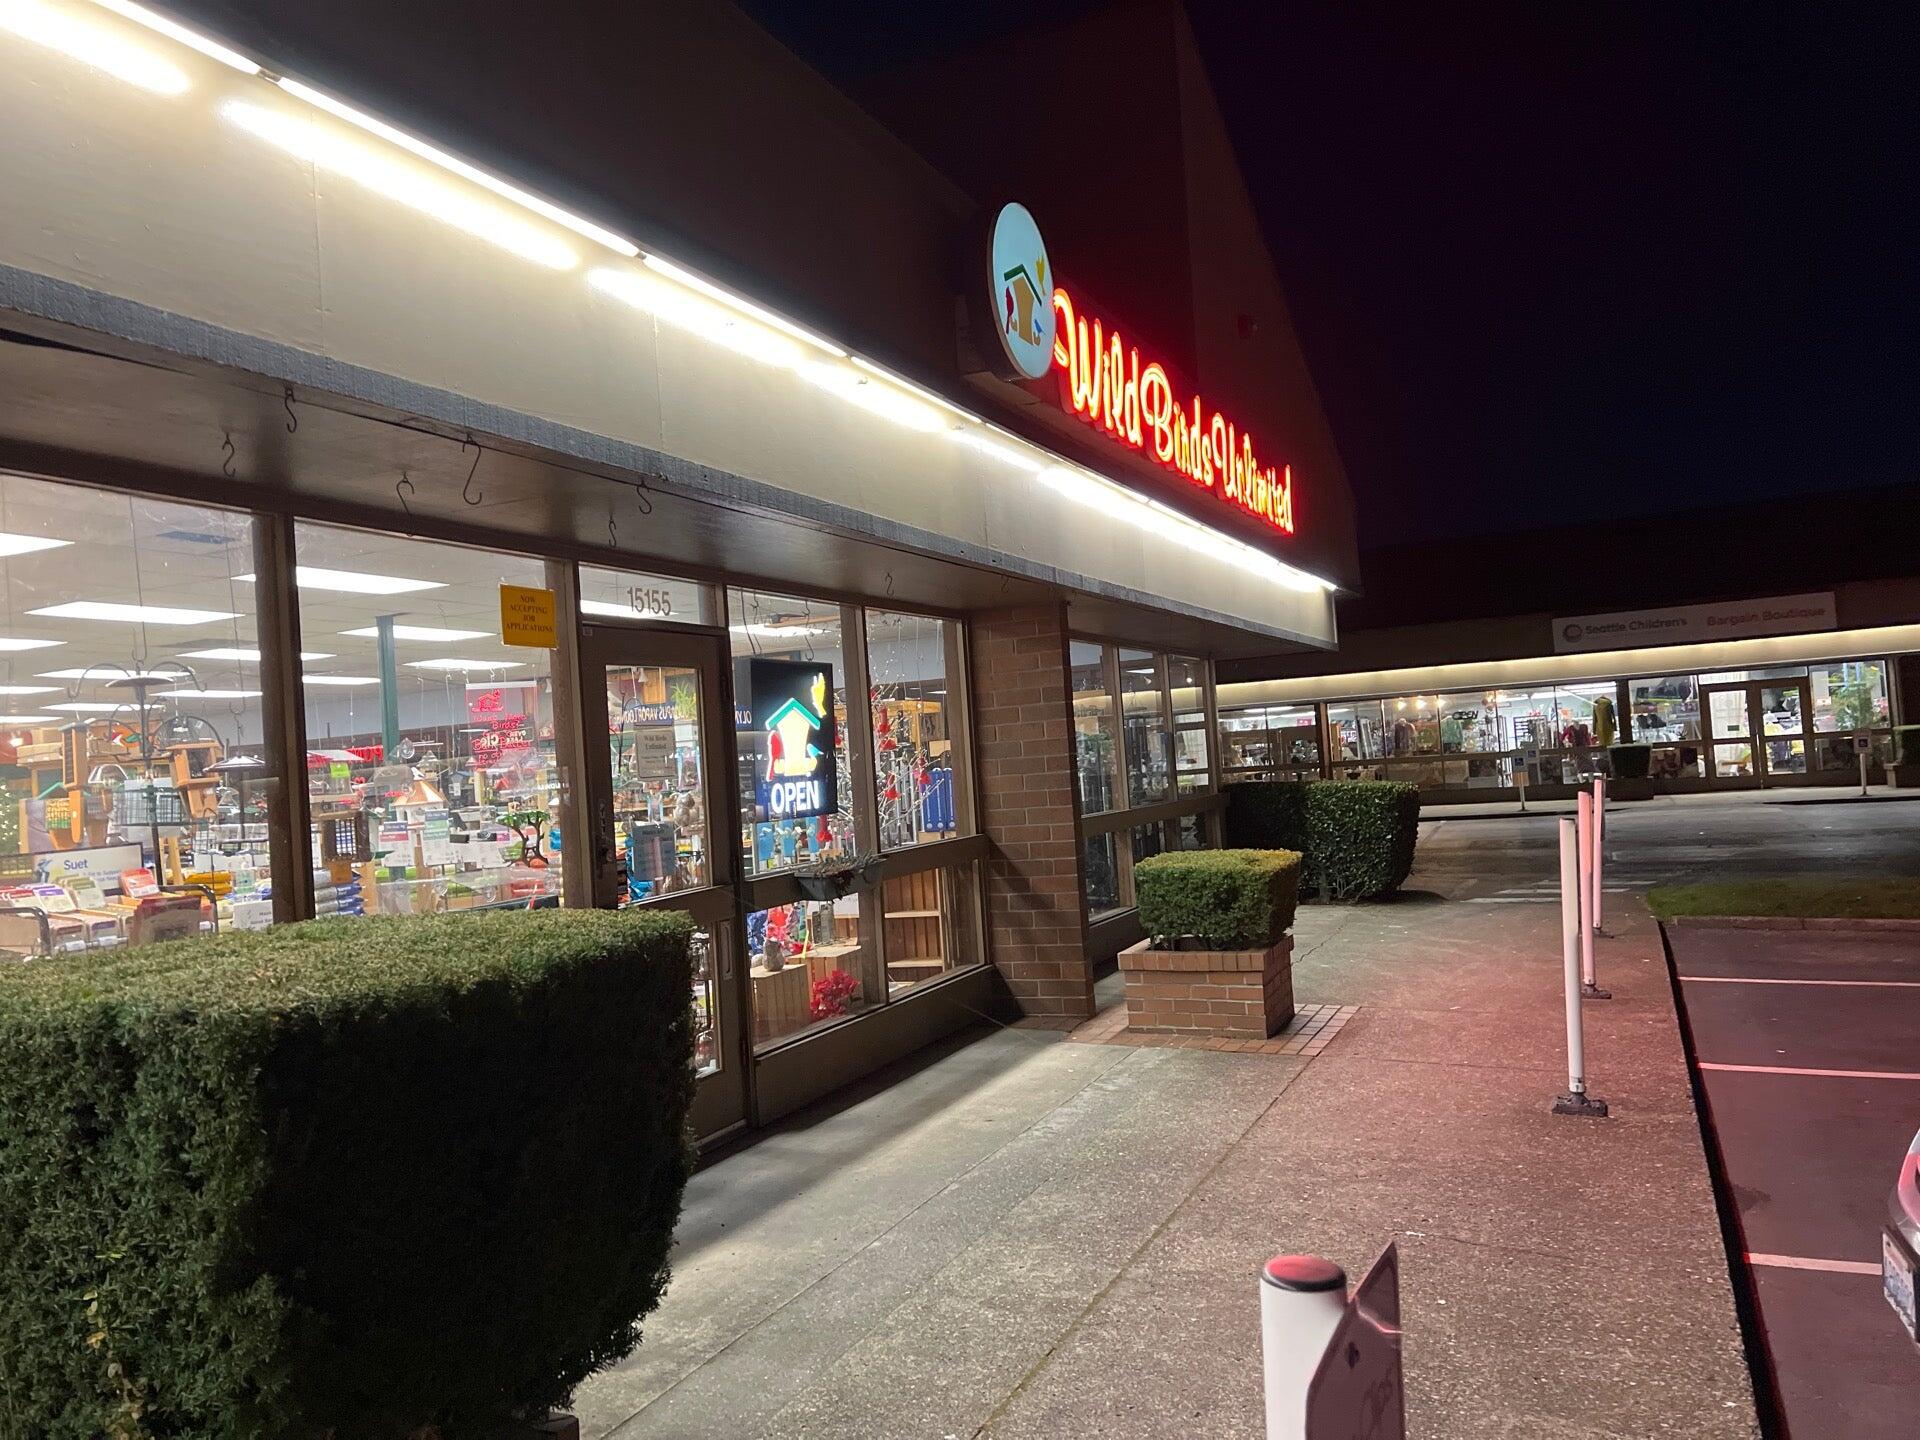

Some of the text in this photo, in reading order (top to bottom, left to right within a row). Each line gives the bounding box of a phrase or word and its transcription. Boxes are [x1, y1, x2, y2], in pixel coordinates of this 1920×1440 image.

[1053, 288, 1294, 534] Wild Birds Unlimited
[520, 594, 535, 602] NOW
[627, 586, 671, 616] 15155
[510, 603, 548, 614] ACCEPTING
[1707, 608, 1826, 627] Bargain Boutique
[505, 622, 553, 632] APPLICATIONS
[1585, 617, 1687, 635] Seattle Children's
[771, 780, 820, 814] OPEN
[64, 859, 88, 870] Suet
